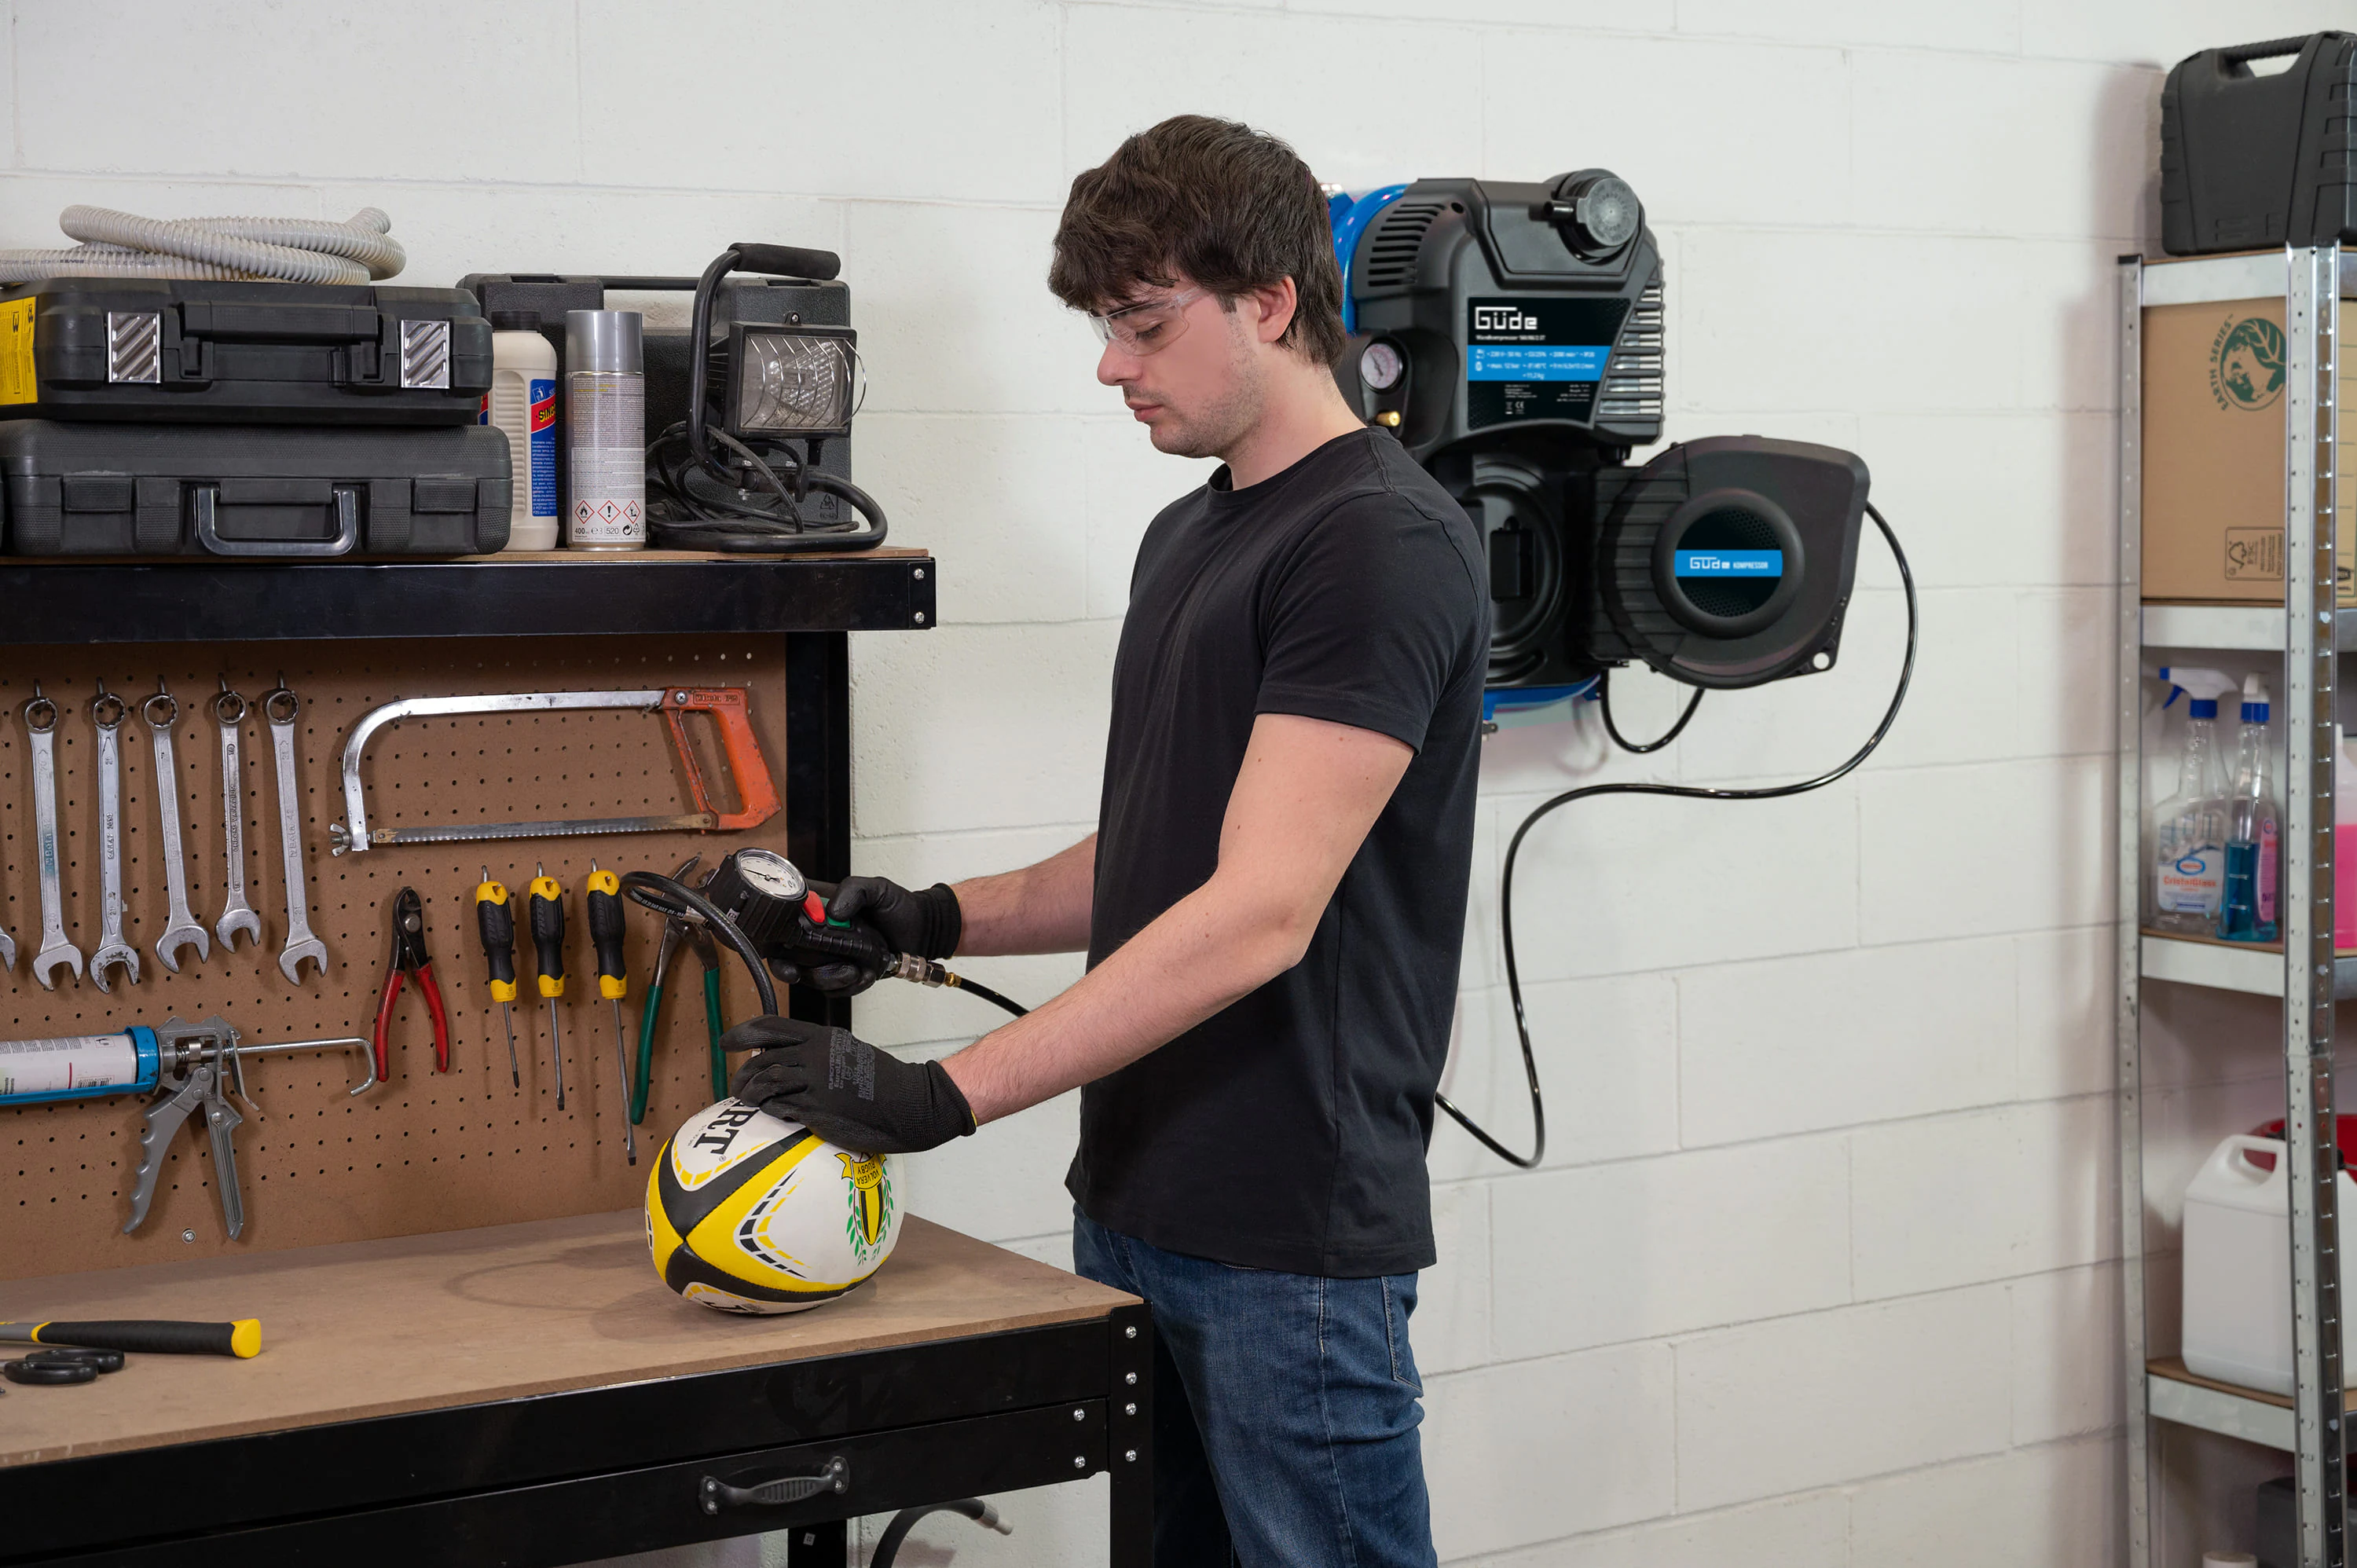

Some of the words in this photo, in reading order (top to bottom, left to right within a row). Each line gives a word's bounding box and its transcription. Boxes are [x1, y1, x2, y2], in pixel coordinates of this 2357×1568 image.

[1475, 306, 1538, 330] Güde
[2209, 319, 2232, 364] SERIES
[2209, 368, 2229, 411] EARTH
[44, 833, 53, 857] Beta
[856, 1169, 880, 1185] VOLVERA
[857, 1160, 876, 1175] RUGBY
